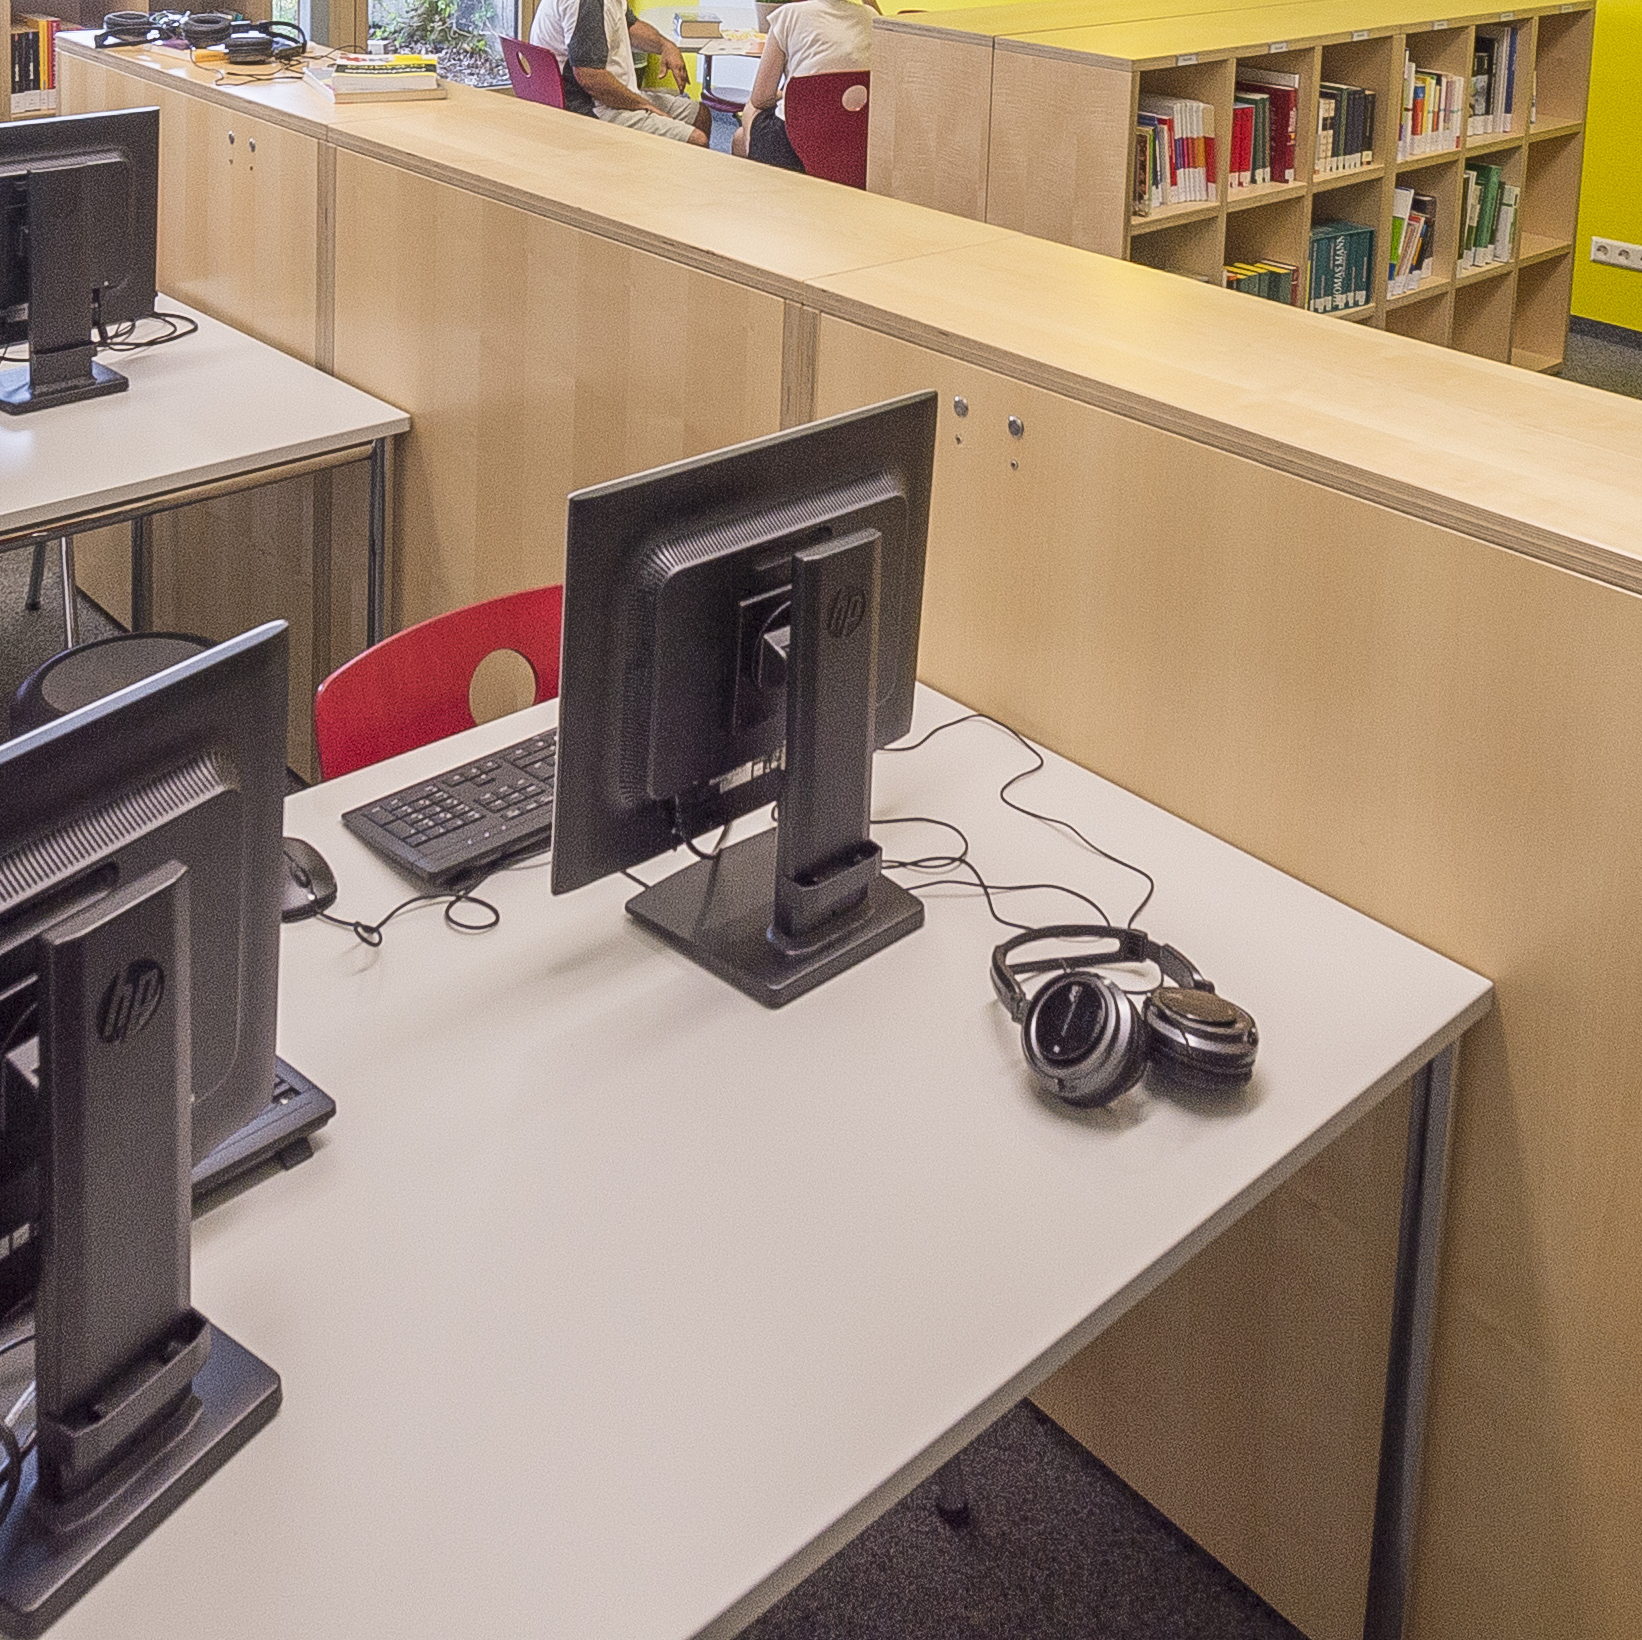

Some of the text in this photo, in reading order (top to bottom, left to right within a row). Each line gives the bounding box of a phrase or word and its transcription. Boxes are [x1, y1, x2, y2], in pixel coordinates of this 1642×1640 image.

[1334, 236, 1345, 265] MANN
[826, 586, 867, 639] hp
[96, 958, 166, 1044] hp
